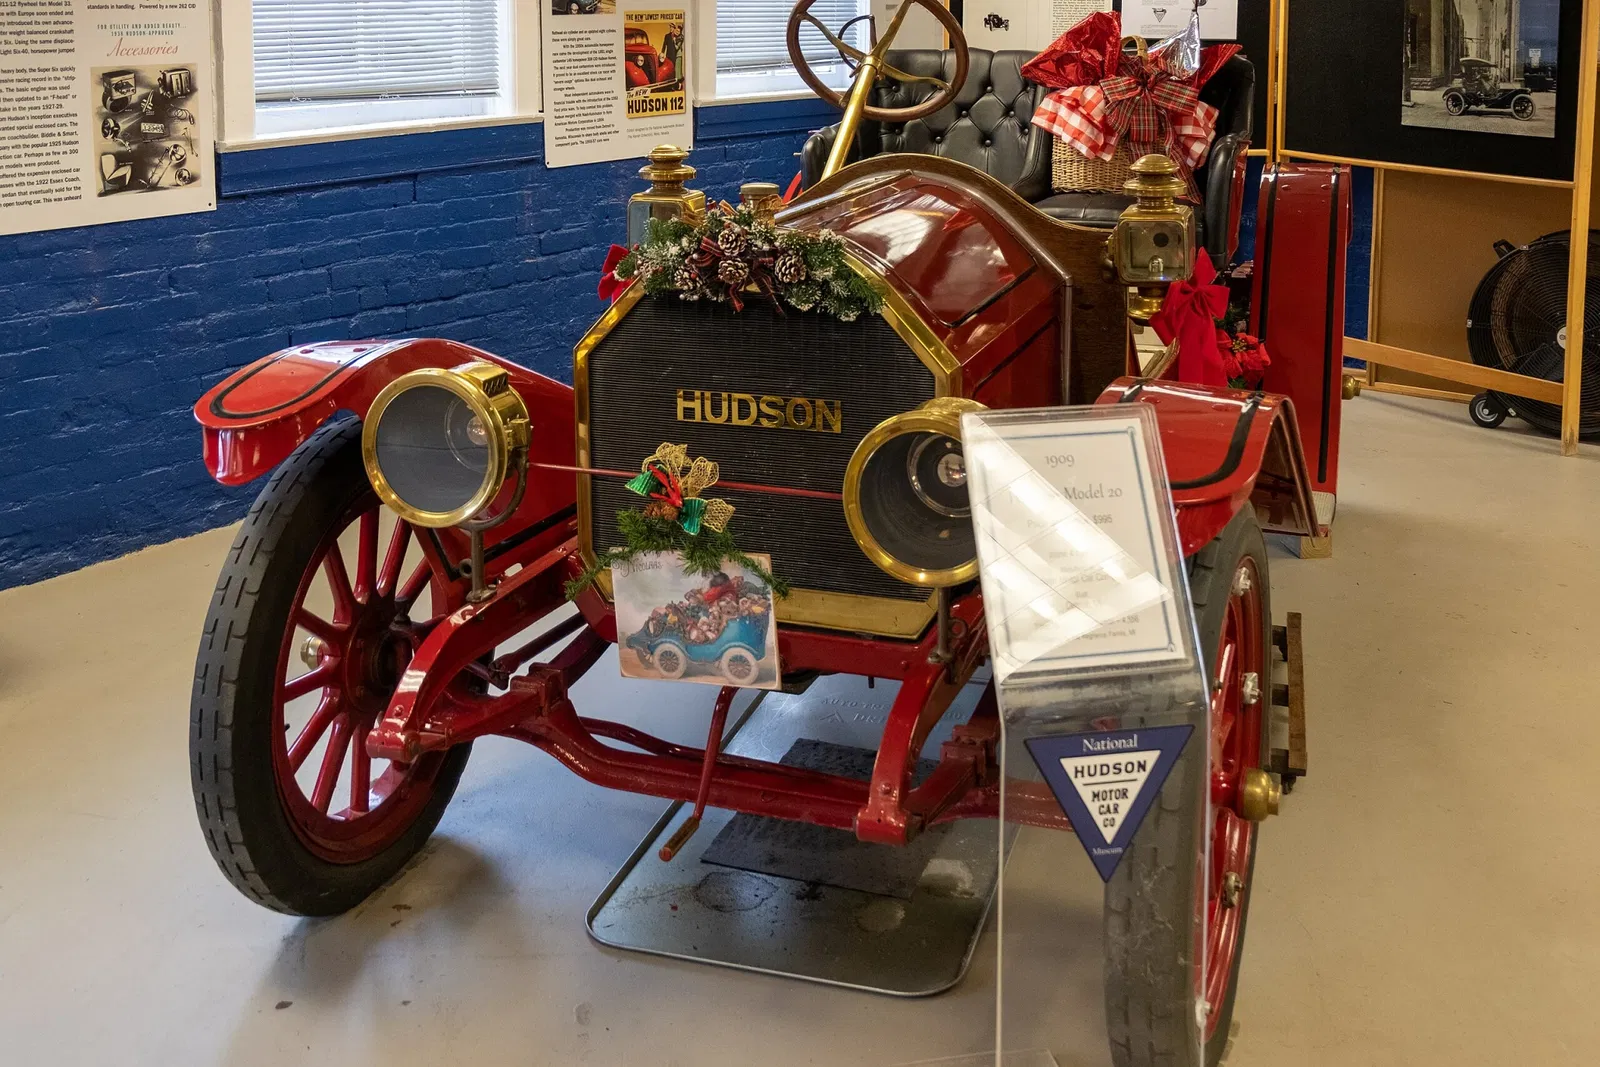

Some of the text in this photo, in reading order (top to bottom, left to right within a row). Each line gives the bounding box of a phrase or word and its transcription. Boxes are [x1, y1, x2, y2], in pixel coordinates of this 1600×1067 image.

[634, 13, 644, 21] NEW
[106, 37, 179, 57] Accessories
[635, 88, 649, 98] NEW
[627, 98, 668, 114] HUDSON
[670, 97, 684, 110] 112
[676, 388, 842, 434] HUDSON
[1045, 453, 1075, 468] 1909
[1063, 483, 1123, 500] Model 20
[1092, 513, 1113, 525] $995
[1082, 733, 1138, 753] National
[1073, 759, 1147, 779] HUDSON
[1091, 787, 1129, 803] MOTOR
[1098, 803, 1120, 816] CAR
[1102, 816, 1116, 828] CO
[1091, 845, 1123, 857] Museum
